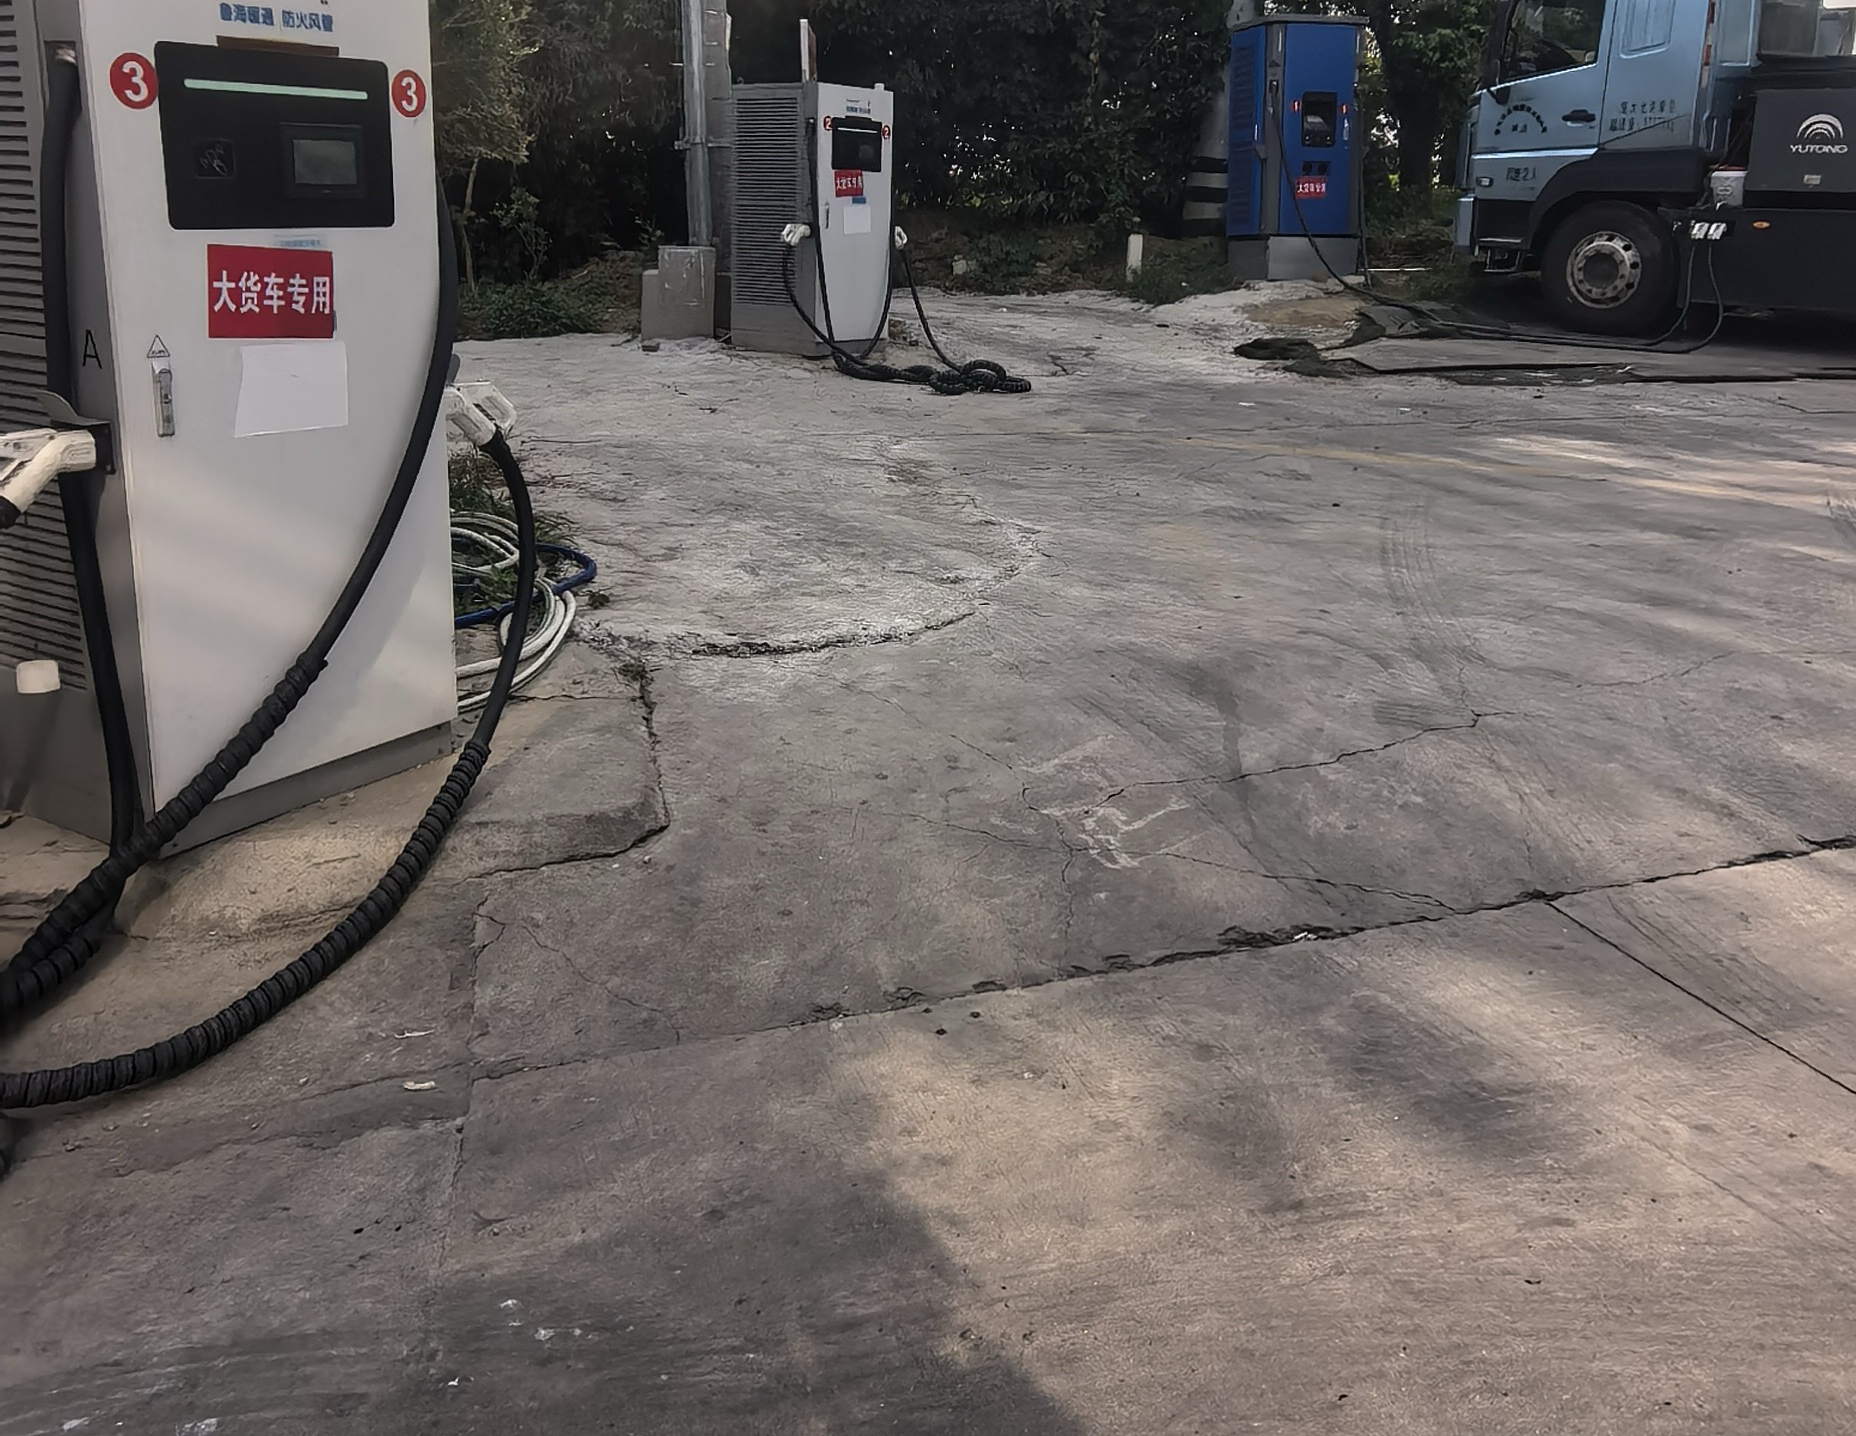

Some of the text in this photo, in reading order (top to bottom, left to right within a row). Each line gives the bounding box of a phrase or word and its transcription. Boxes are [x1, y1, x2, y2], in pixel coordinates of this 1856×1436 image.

[121, 60, 148, 103] 3
[401, 76, 418, 112] 3
[212, 270, 331, 314] 大货车专用
[82, 329, 103, 369] A
